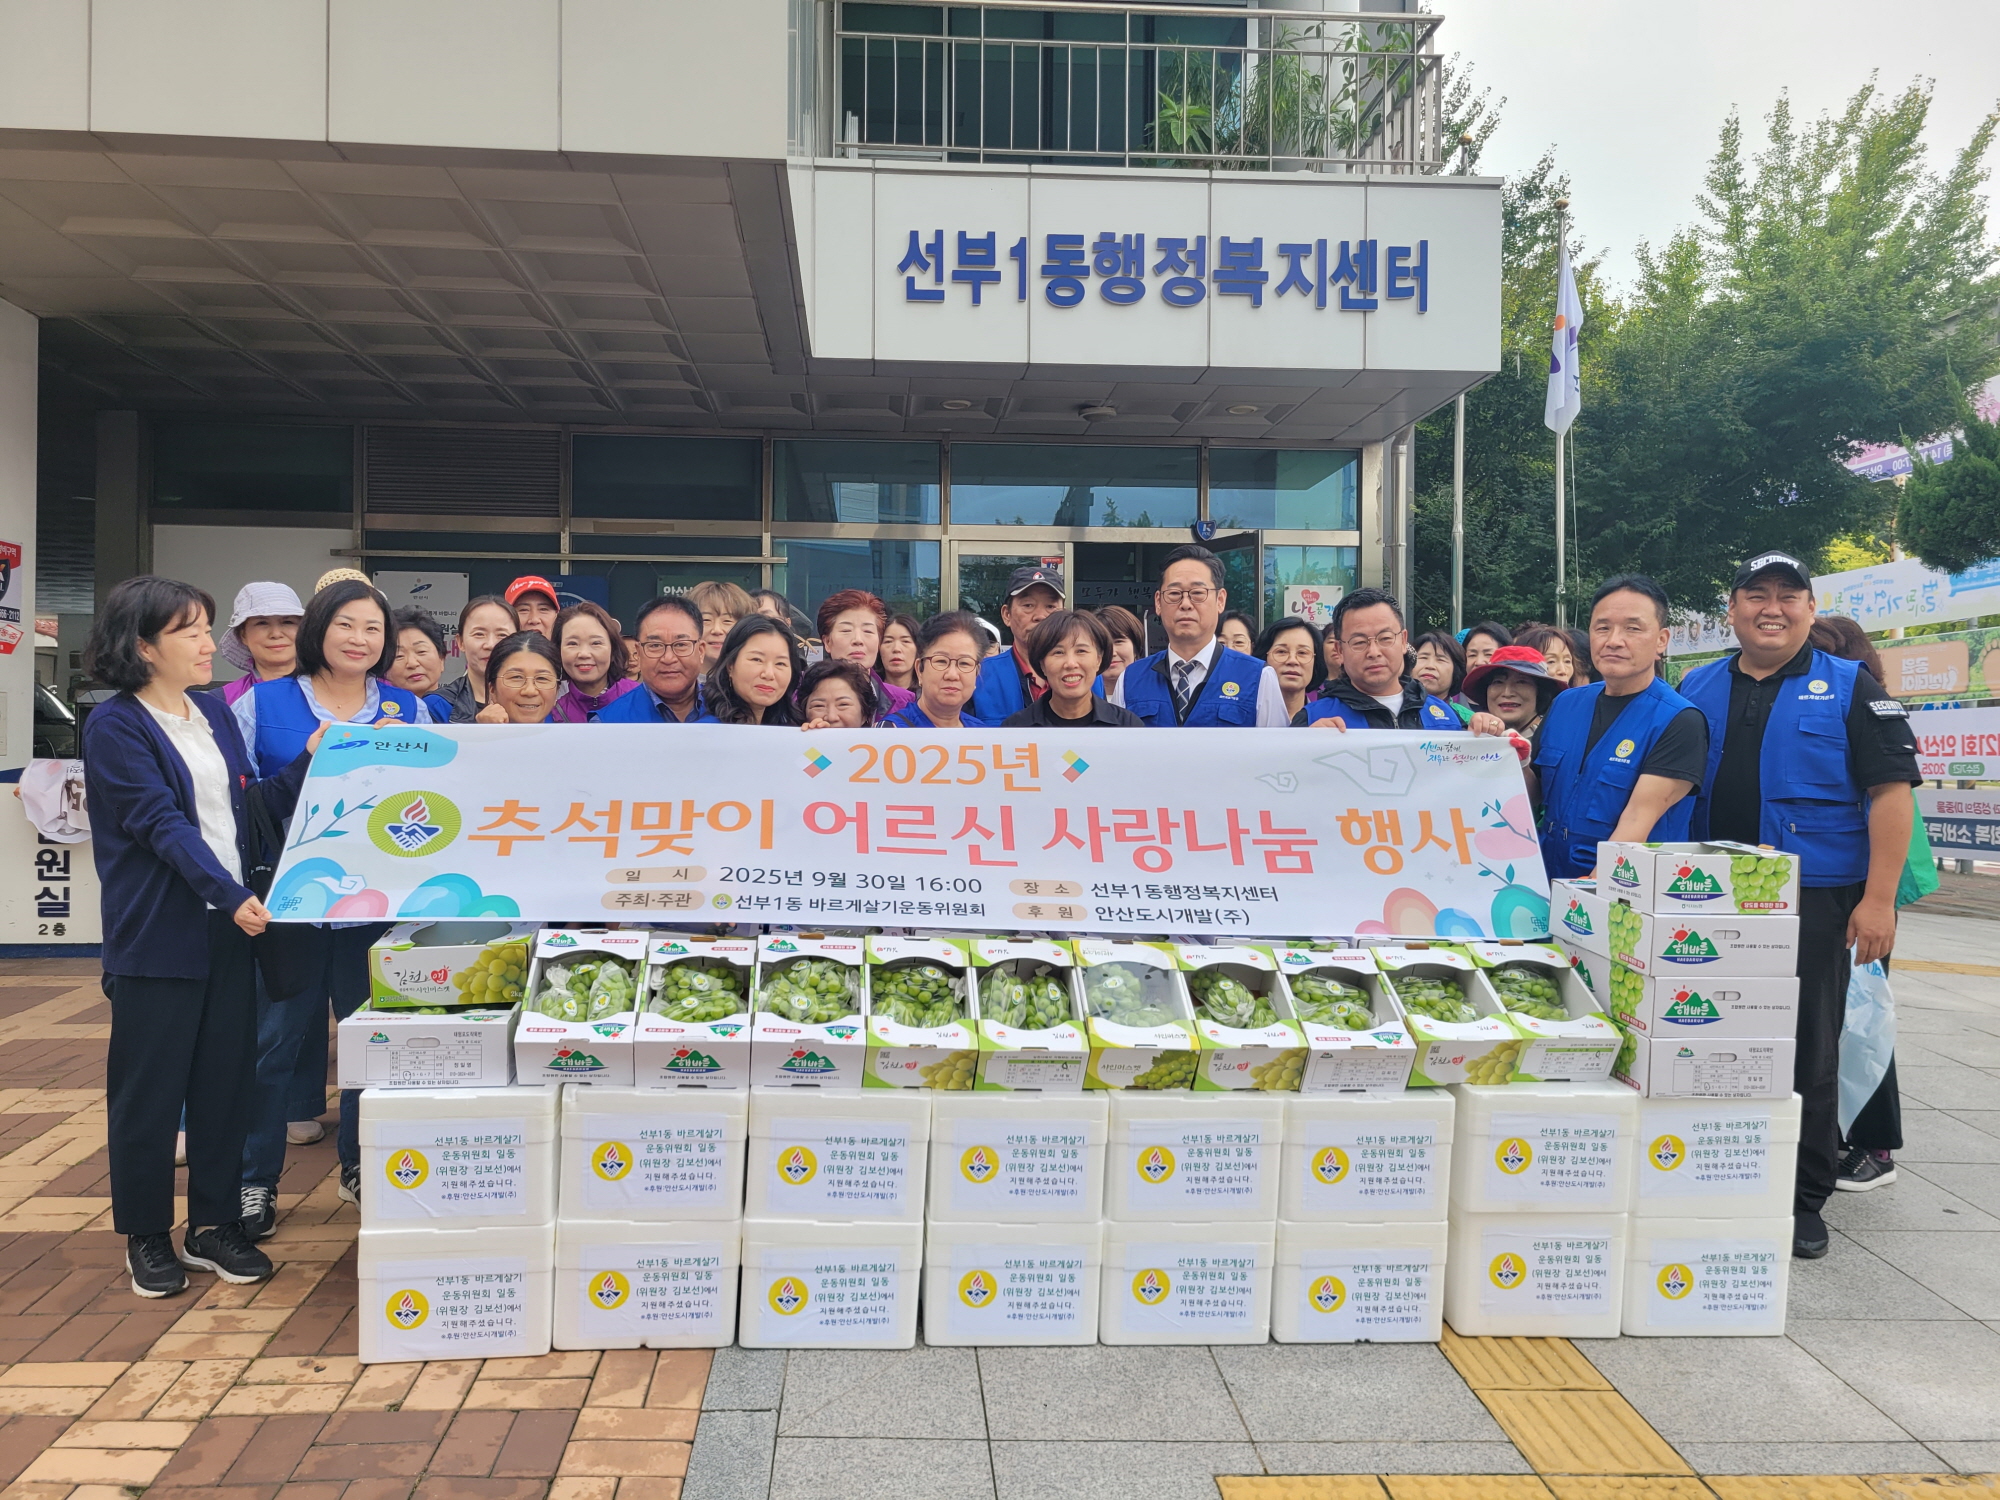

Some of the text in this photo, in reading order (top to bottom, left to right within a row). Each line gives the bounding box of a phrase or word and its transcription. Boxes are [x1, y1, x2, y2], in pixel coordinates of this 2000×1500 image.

[897, 228, 1429, 314] 선부1동행정복지센터
[1081, 586, 1119, 599] 모두가
[1869, 700, 1904, 712] SECURITY
[374, 740, 429, 753] 안산시
[848, 742, 1042, 793] 2025년
[467, 799, 1476, 876] 추석맞이 어르신 사랑나눔 행사
[719, 866, 983, 894] 2025년 9월 30일 16:00
[1676, 878, 1713, 892] 해바른
[1090, 882, 1280, 902] 선부1동행정복지센터
[615, 892, 692, 909] 주최·주관
[735, 894, 986, 917] 선부1동 바르게살기운동위원회
[1095, 906, 1251, 925] 안산도시개발(주)
[1672, 941, 1708, 955] 해바른
[1674, 1002, 1709, 1016] 해바른
[557, 1057, 593, 1066] 해바른
[675, 1057, 710, 1067] 해바른
[792, 1058, 825, 1068] 해바른
[1691, 1120, 1767, 1132] 선부1동 바르게살기
[435, 1134, 522, 1146] 선부1동 바르게살기
[825, 1136, 906, 1147] 선부1동 바르게살기
[1182, 1133, 1259, 1144] 선부1동 바르게살기
[1697, 1134, 1762, 1145] 운동위원회 일동
[442, 1149, 516, 1161] 운동위원회 일동
[830, 1150, 899, 1162] 운동위원회 일동
[1187, 1147, 1253, 1158] 운동위원회 일동
[1691, 1147, 1765, 1159] (위원장 김보선)에서
[435, 1163, 521, 1176] (위원장 김보선)에서
[823, 1164, 903, 1177] (위원장 김보선)에서
[1181, 1161, 1257, 1173] (위원장 김보선)에서
[1696, 1161, 1761, 1171] 지원해주셨습니다.
[442, 1178, 516, 1189] 지원해주셨습니다.
[828, 1178, 898, 1190] 지원해주셨습니다.
[1186, 1175, 1253, 1185] 지원해주셨습니다.
[636, 1257, 719, 1269] 선부1동 바르게살기
[1700, 1252, 1775, 1263] 선부1동 바르게살기
[1004, 1259, 1083, 1269] 선부1동 바르게살기
[1705, 1265, 1769, 1275] 운동위원회 일동
[642, 1270, 713, 1282] 운동위원회 일동
[1009, 1272, 1076, 1283] 운동위원회 일동
[1699, 1278, 1772, 1290] (위원장 김보선)에서
[636, 1284, 718, 1297] (위원장 김보선)에서
[1003, 1286, 1080, 1298] (위원장 김보선)에서
[1703, 1292, 1767, 1302] 지원해주셨습니다.
[641, 1300, 713, 1310] 지원해주셨습니다.
[1008, 1301, 1075, 1311] 지원해주셨습니다.
